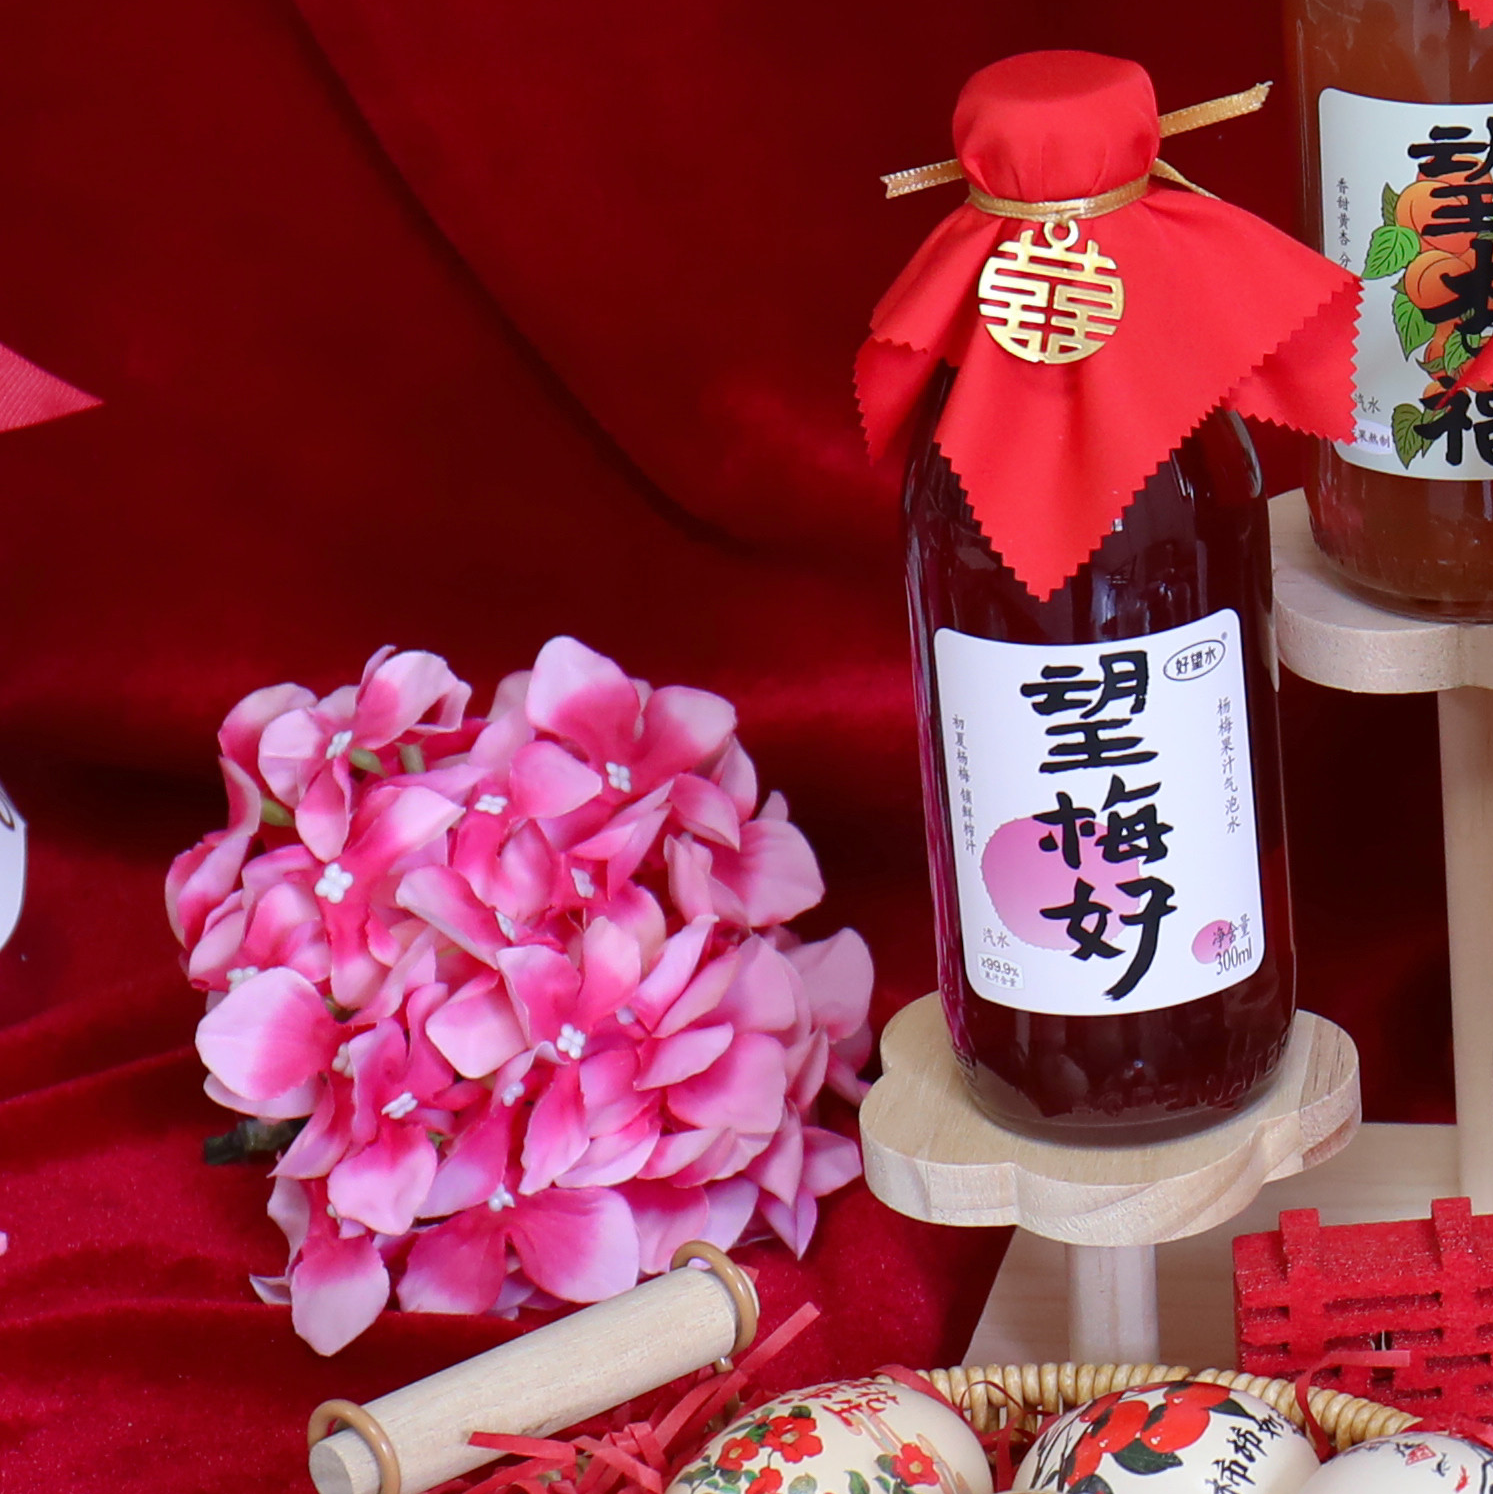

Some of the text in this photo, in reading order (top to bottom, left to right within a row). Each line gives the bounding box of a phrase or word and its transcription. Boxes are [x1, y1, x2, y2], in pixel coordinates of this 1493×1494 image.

[1176, 647, 1217, 676] 好望水
[1217, 698, 1241, 834] 杨梅果汁气泡水
[1021, 650, 1177, 1001] 望梅好
[983, 928, 1010, 948] 汽水
[1212, 913, 1251, 949] 净含量
[1215, 939, 1253, 976] 300ml
